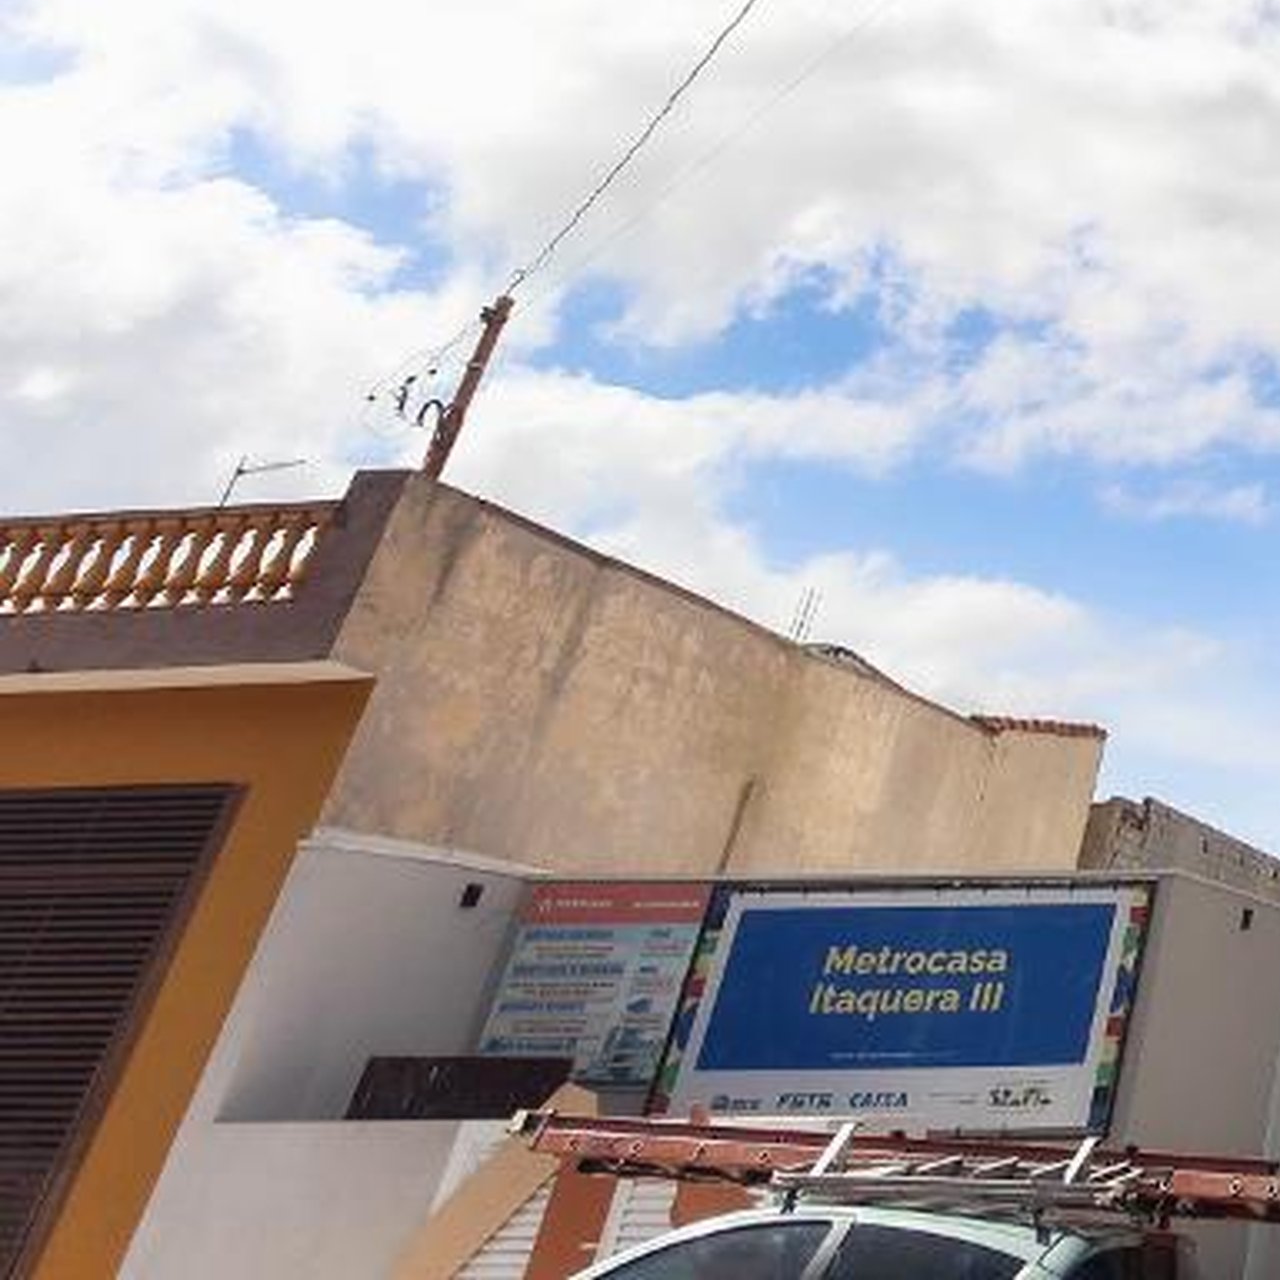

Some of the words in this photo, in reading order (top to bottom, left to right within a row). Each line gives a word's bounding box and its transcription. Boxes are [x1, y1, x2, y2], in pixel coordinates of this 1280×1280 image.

[824, 945, 1008, 975] Metrocasa
[809, 982, 960, 1021] Itaquera
[969, 981, 1005, 1012] III
